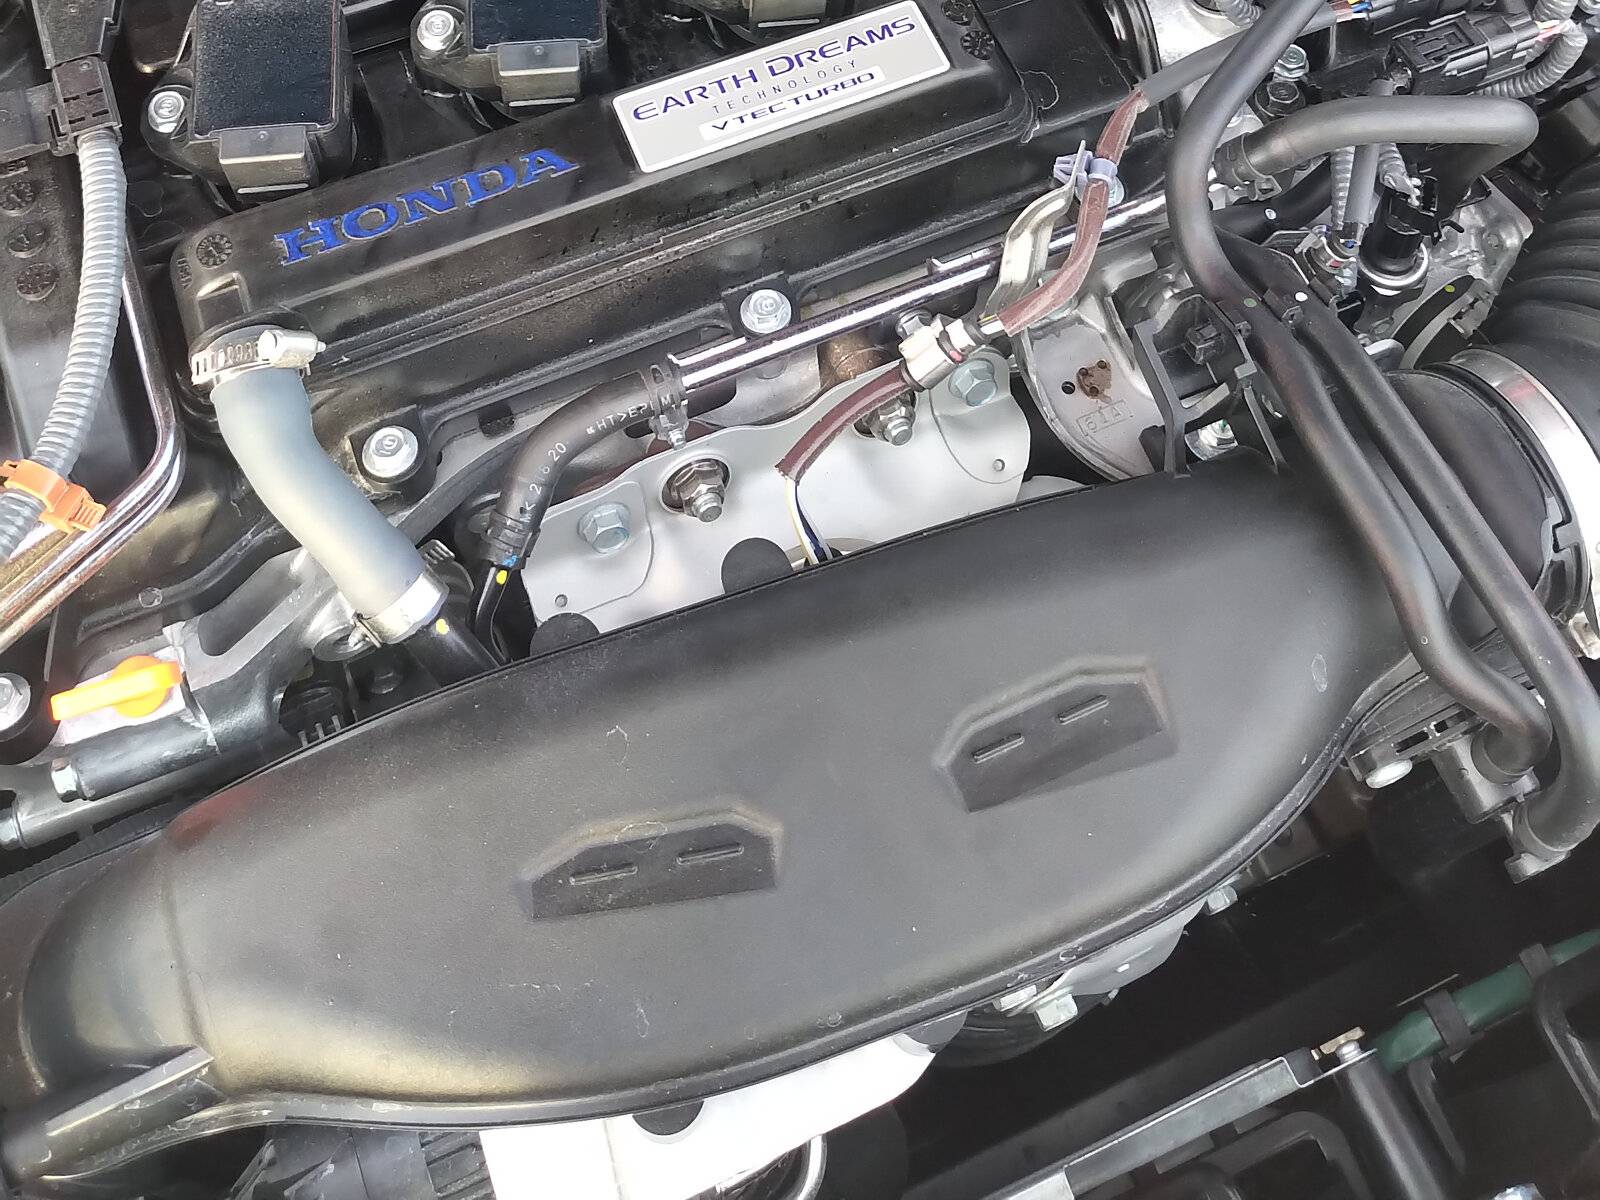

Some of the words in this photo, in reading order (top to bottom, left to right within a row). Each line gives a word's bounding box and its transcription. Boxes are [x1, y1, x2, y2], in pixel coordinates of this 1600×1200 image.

[632, 69, 759, 121] EARTH
[765, 16, 916, 77] DREAMS
[712, 59, 857, 114] TECHNOLOGY
[788, 71, 875, 106] TURBO
[274, 148, 580, 266] HONDA
